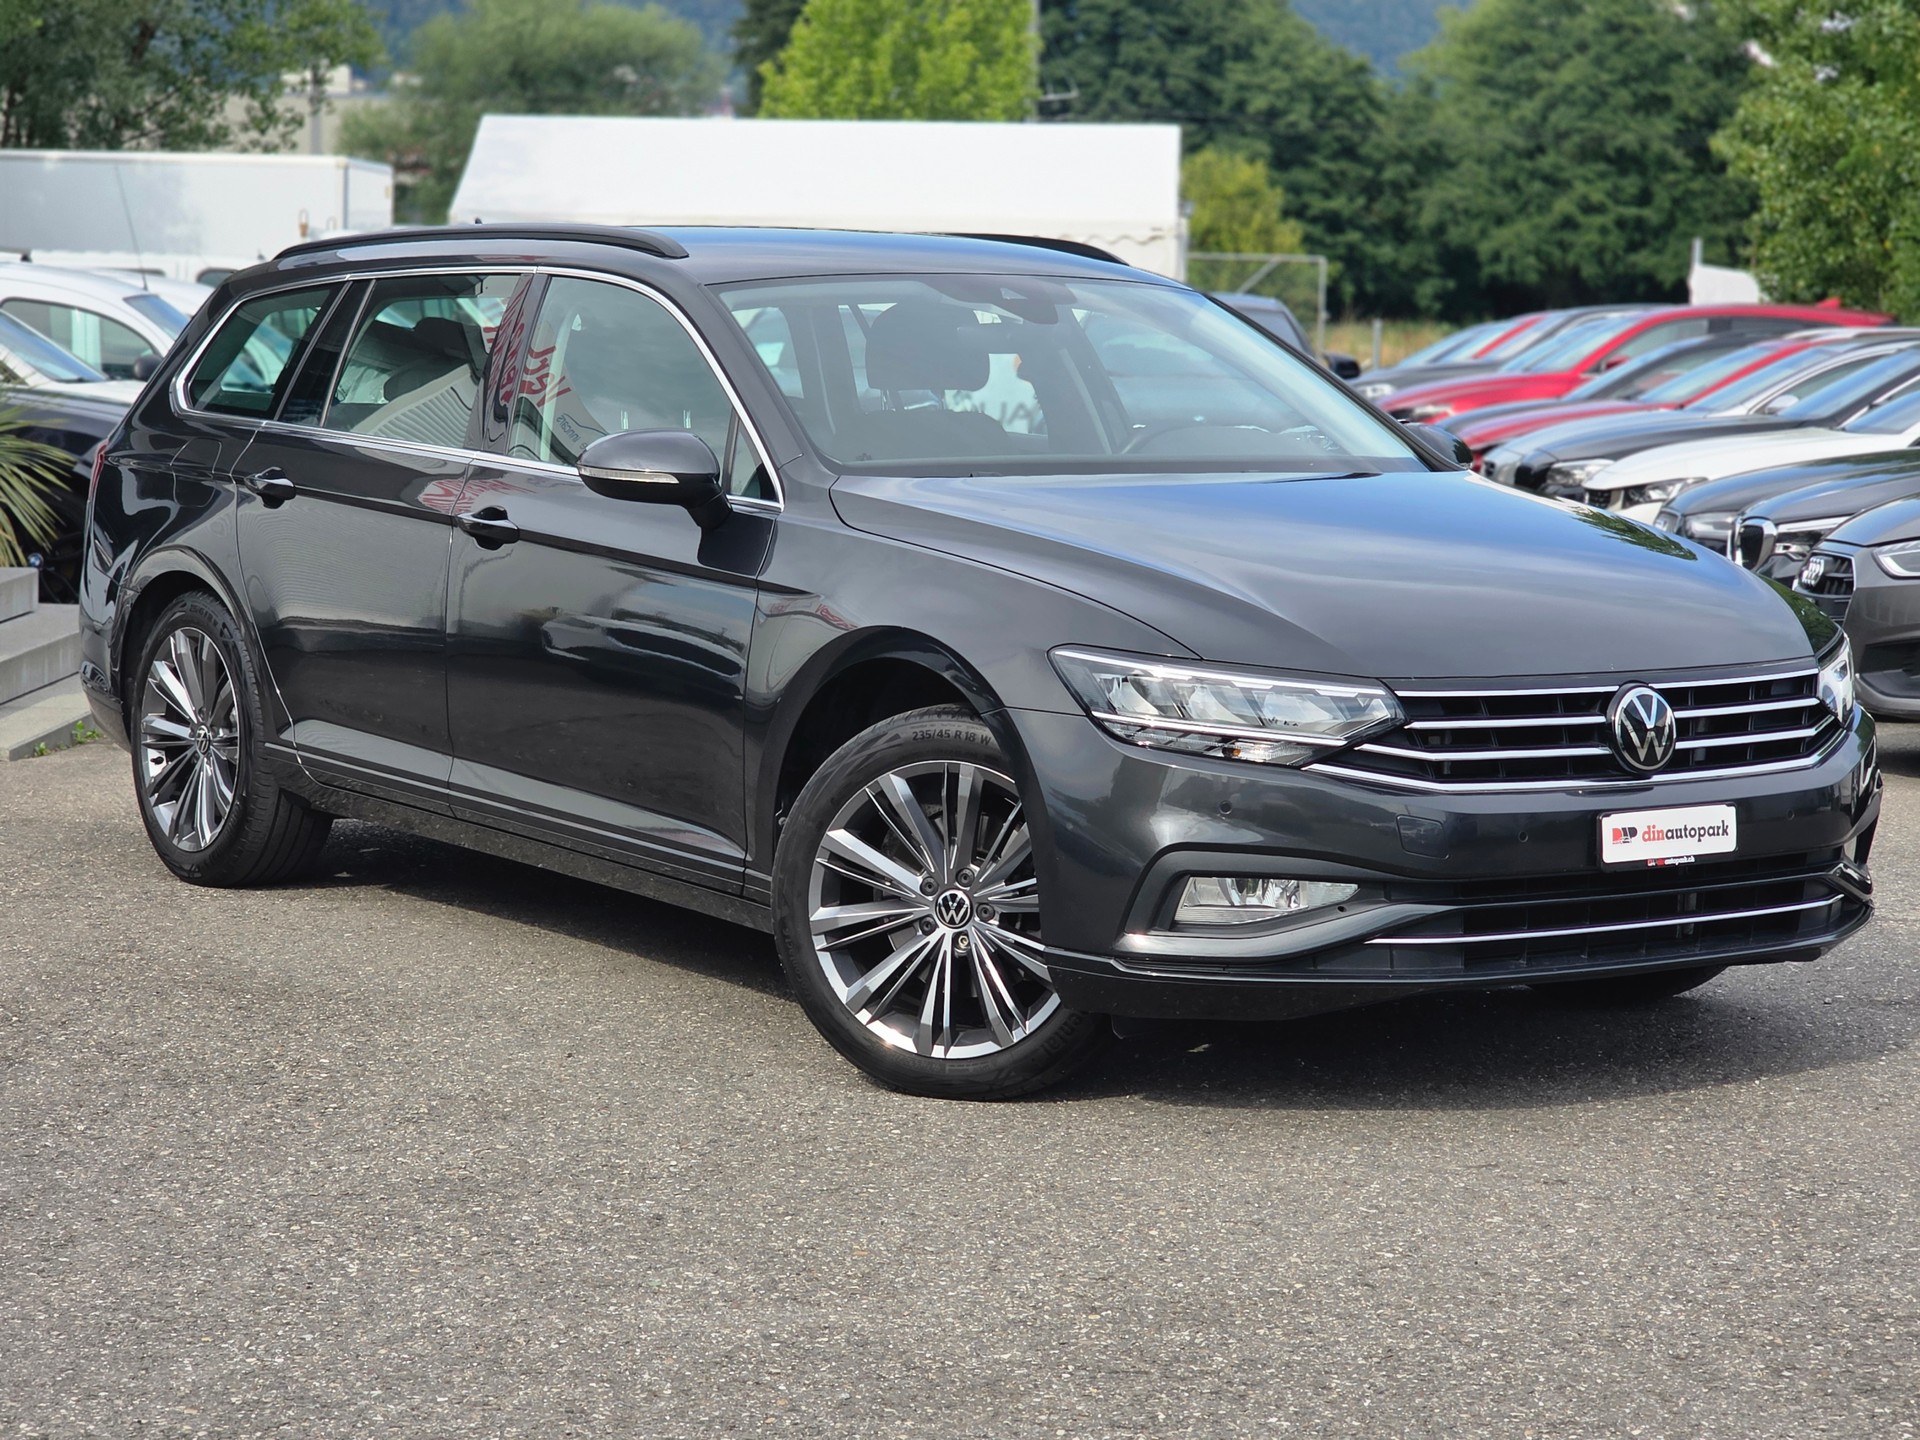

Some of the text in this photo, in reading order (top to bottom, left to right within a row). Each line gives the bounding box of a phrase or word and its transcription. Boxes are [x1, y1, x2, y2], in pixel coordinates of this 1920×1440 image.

[912, 729, 992, 746] 235/45 R 18 W
[1641, 820, 1729, 842] dinautopark
